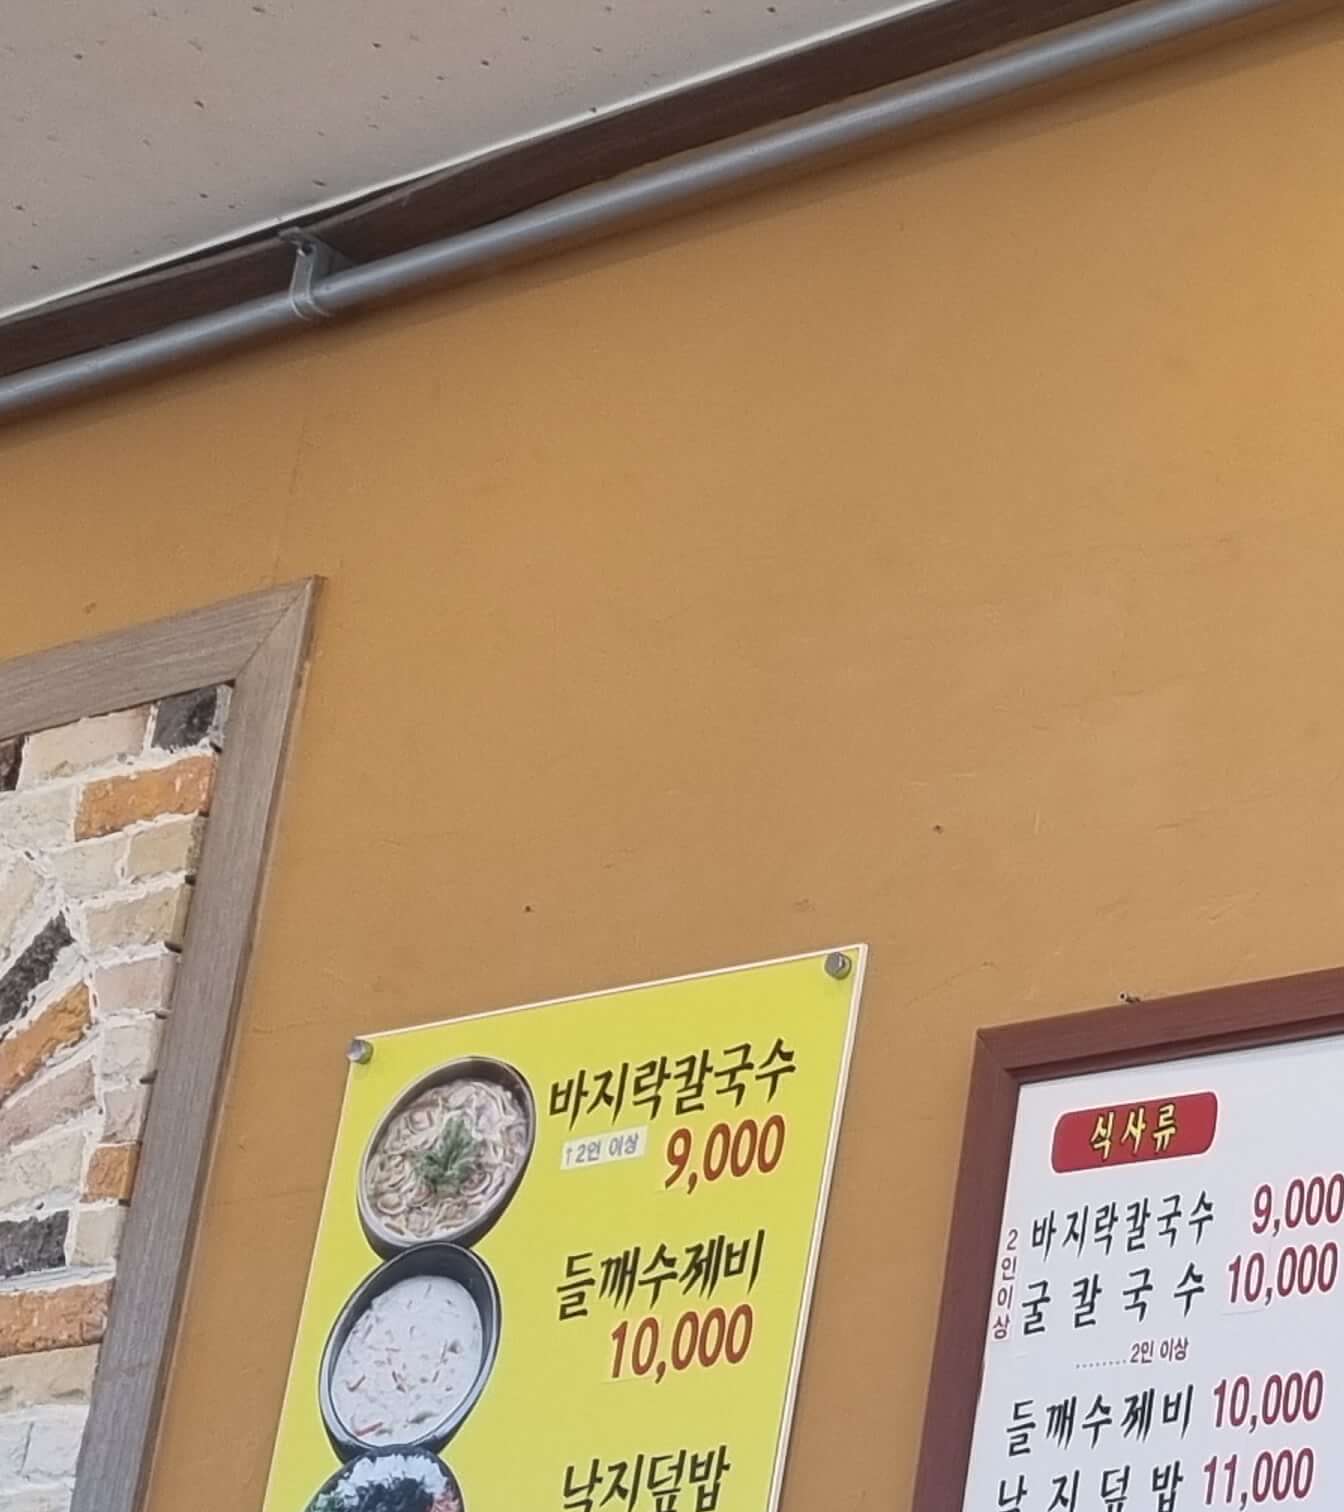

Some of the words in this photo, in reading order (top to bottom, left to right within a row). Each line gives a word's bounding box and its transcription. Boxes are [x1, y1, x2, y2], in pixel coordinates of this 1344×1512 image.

[548, 1037, 796, 1129] 바지락칼국수
[665, 1115, 786, 1195] 9,000
[1090, 1103, 1177, 1160] 식사류
[1032, 1190, 1215, 1261] 바지락칼국수
[556, 1229, 766, 1321] 들깨수제비
[1227, 1242, 1339, 1306] 10,000
[611, 1303, 753, 1384] 10,000
[1006, 1384, 1194, 1457] 들깨수제비
[1213, 1369, 1324, 1434] 10,000
[1203, 1447, 1314, 1512] 11,000
